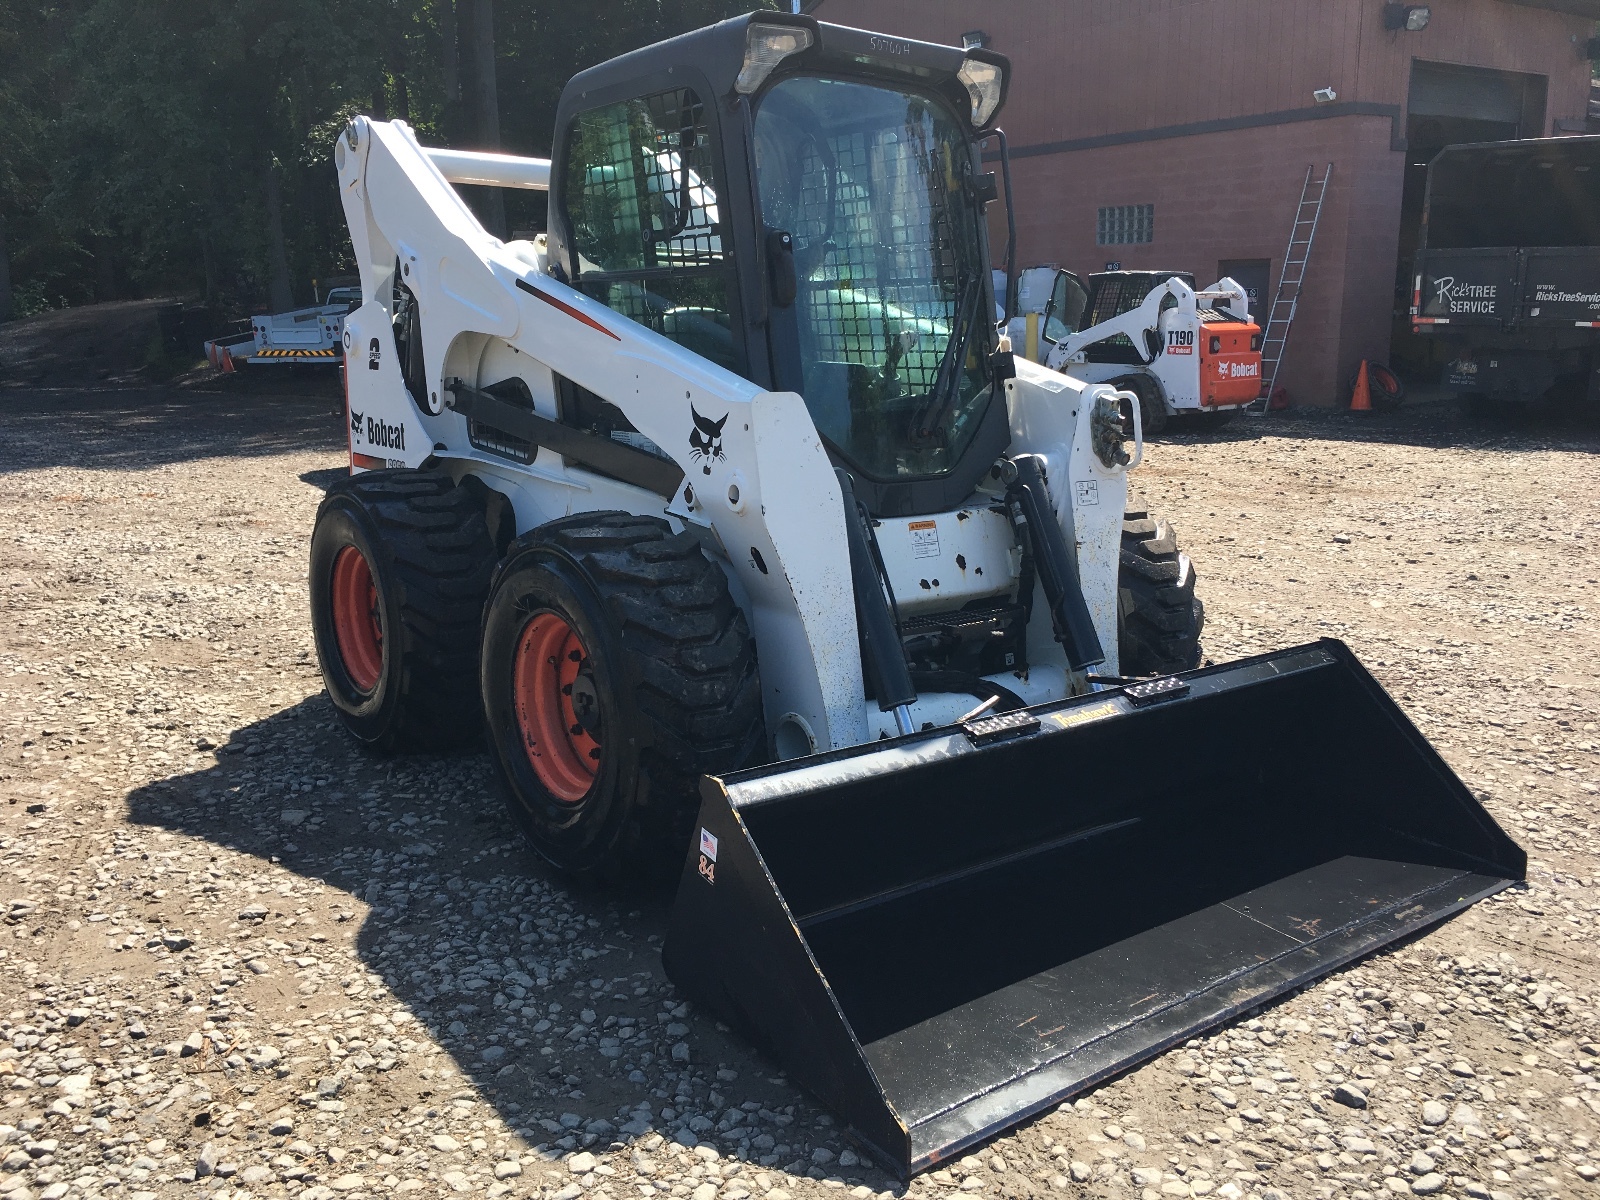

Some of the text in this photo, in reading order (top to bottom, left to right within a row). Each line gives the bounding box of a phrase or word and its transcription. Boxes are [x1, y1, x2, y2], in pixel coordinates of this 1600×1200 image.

[1470, 285, 1497, 298] TREE
[1450, 300, 1495, 314] SERVICE
[1168, 330, 1194, 346] T190
[368, 337, 380, 370] 2
[1231, 361, 1258, 377] Bobcat
[367, 416, 405, 451] Bobcat
[698, 854, 715, 883] 84
